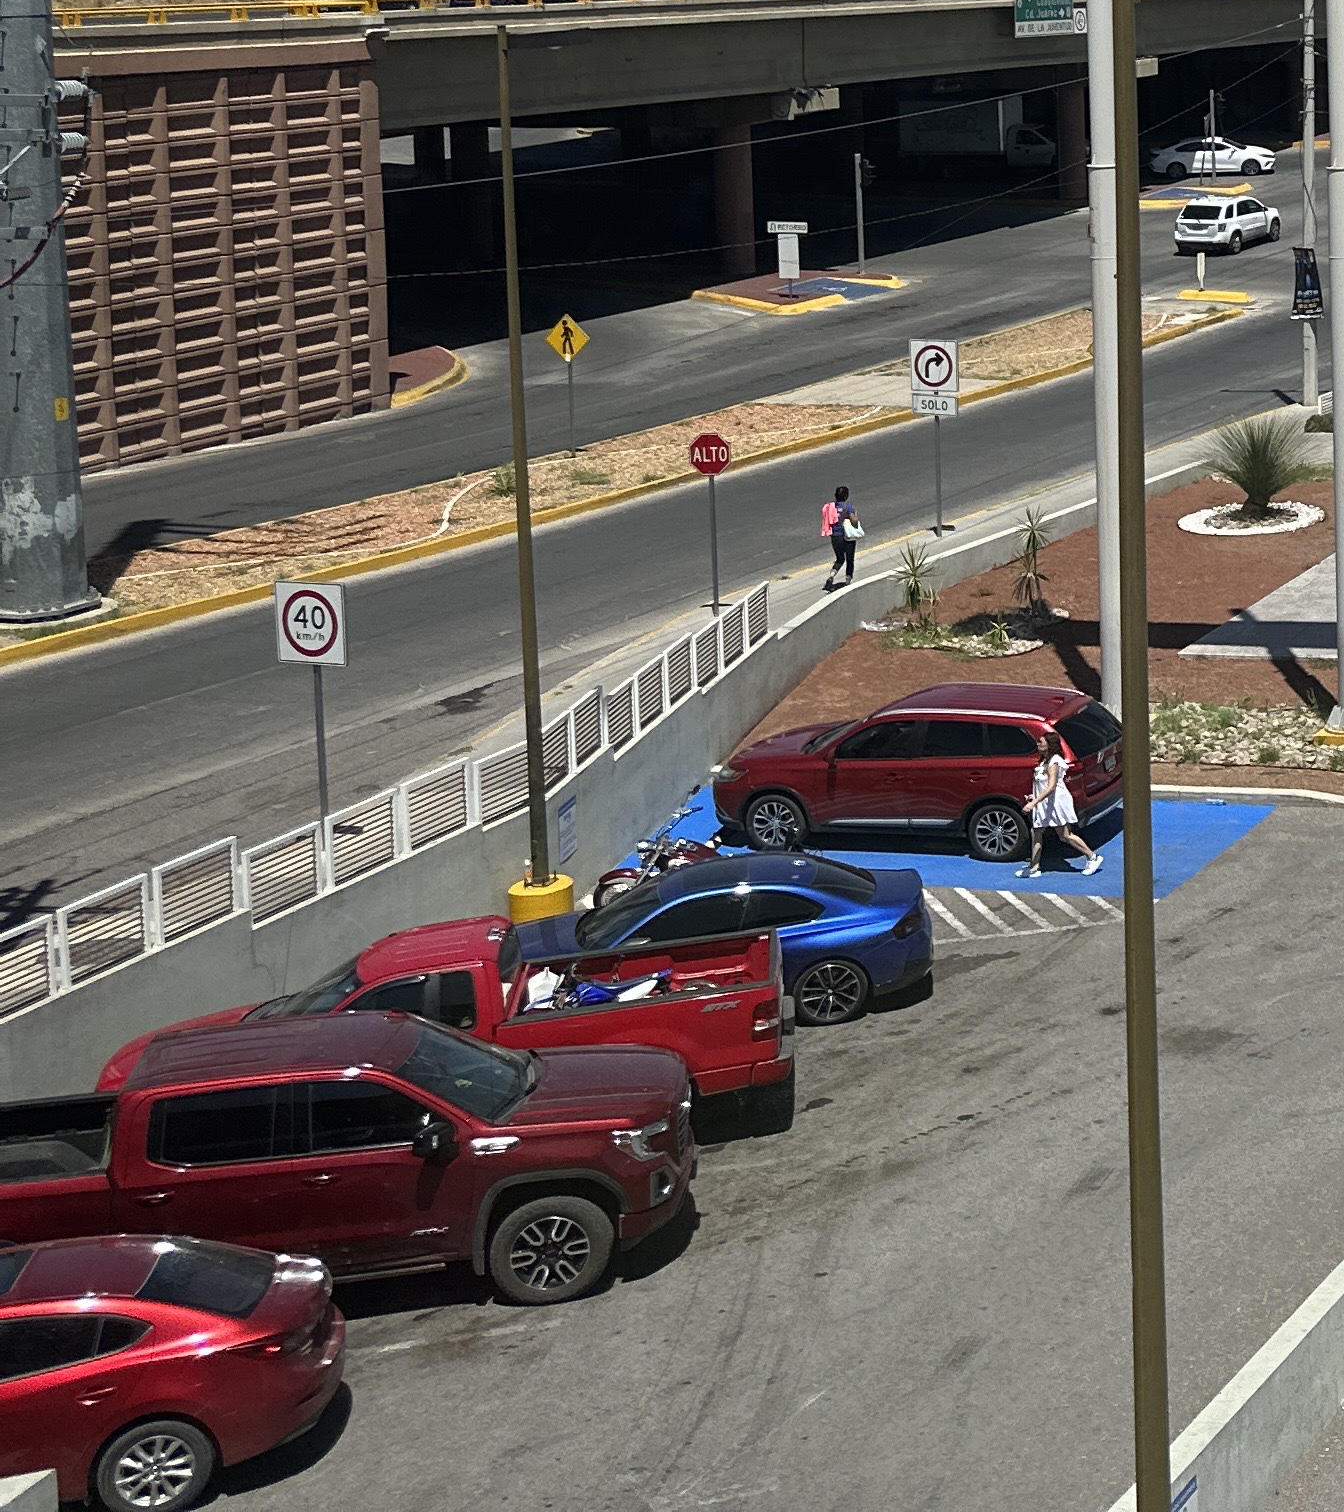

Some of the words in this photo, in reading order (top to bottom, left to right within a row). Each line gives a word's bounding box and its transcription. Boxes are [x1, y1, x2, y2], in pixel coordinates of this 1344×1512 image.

[920, 399, 949, 411] SOLO
[692, 446, 728, 463] ALTO
[293, 604, 326, 630] 40
[295, 631, 325, 642] km/h
